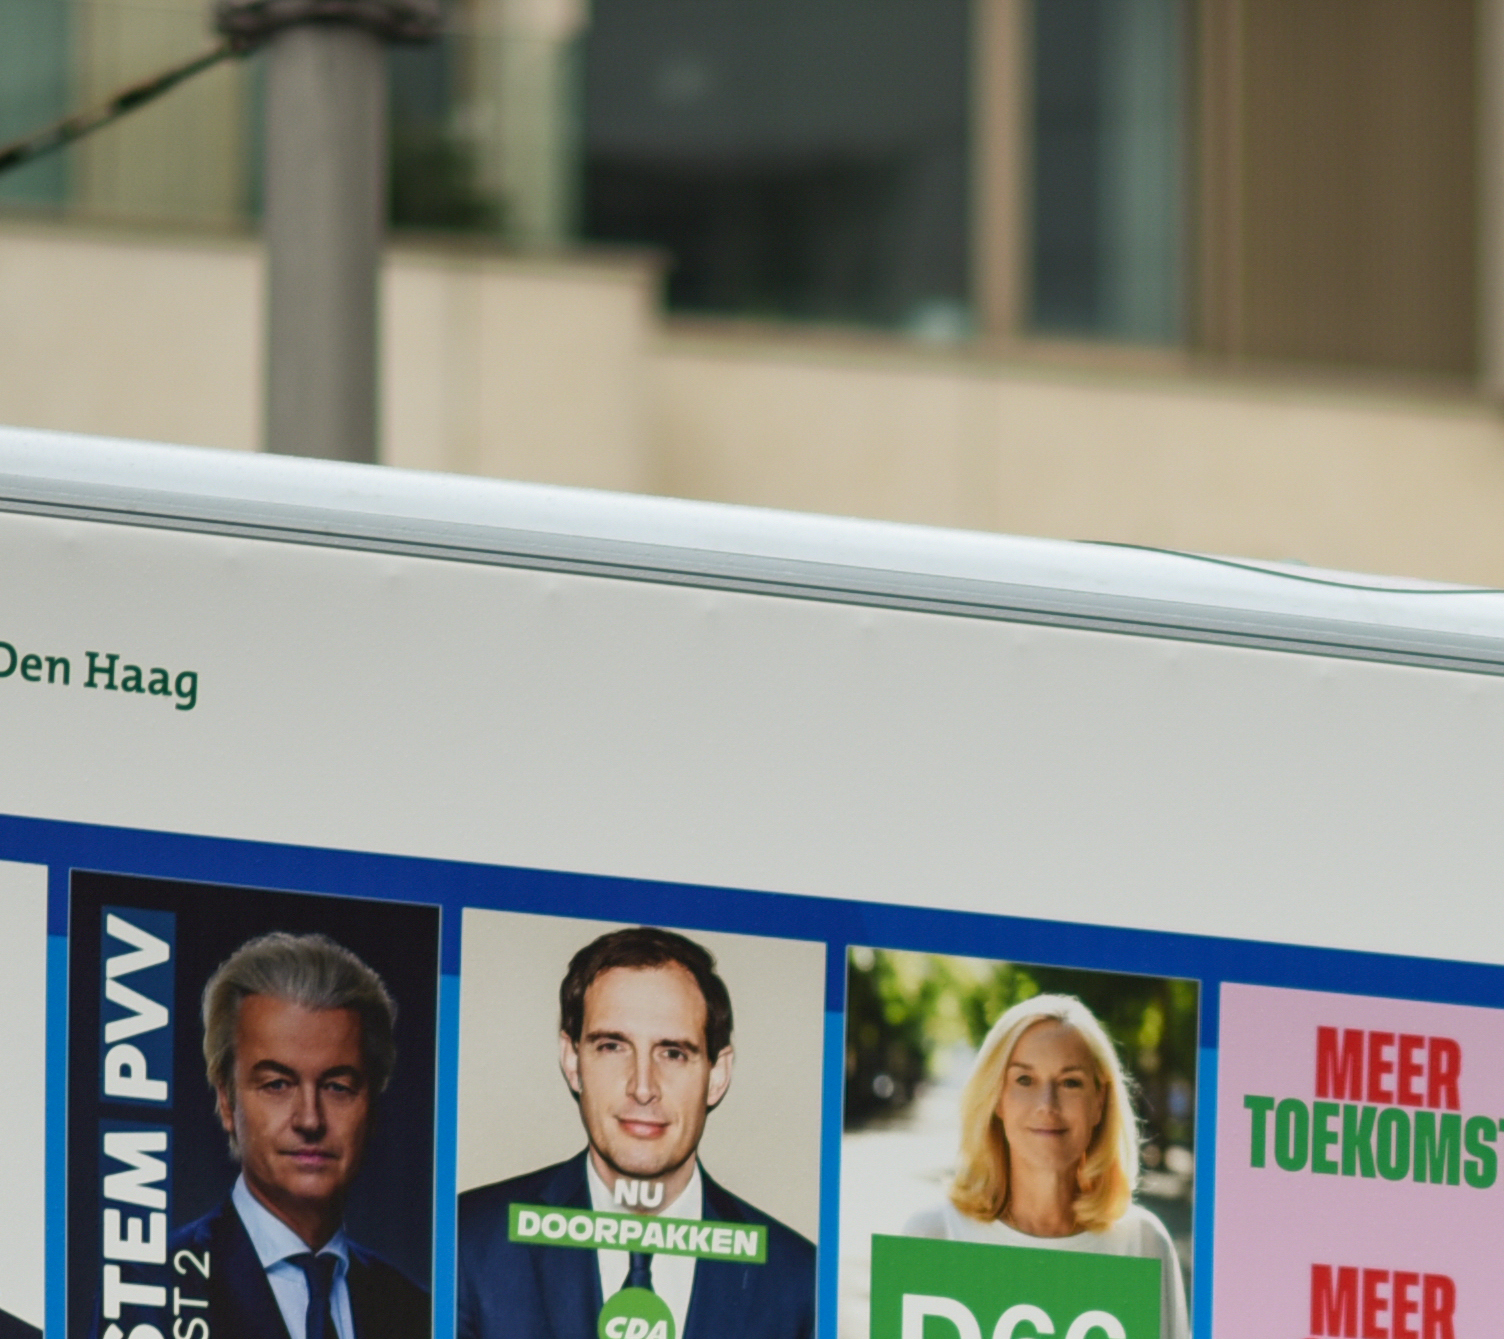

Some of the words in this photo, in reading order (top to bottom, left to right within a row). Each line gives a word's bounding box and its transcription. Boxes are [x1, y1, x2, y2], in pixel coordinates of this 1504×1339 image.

[84, 651, 199, 711] Haag
[104, 914, 171, 1101] PVV
[1315, 1025, 1462, 1111] MEER
[614, 1179, 665, 1209] NU
[517, 1211, 758, 1257] DOORPAKKEN
